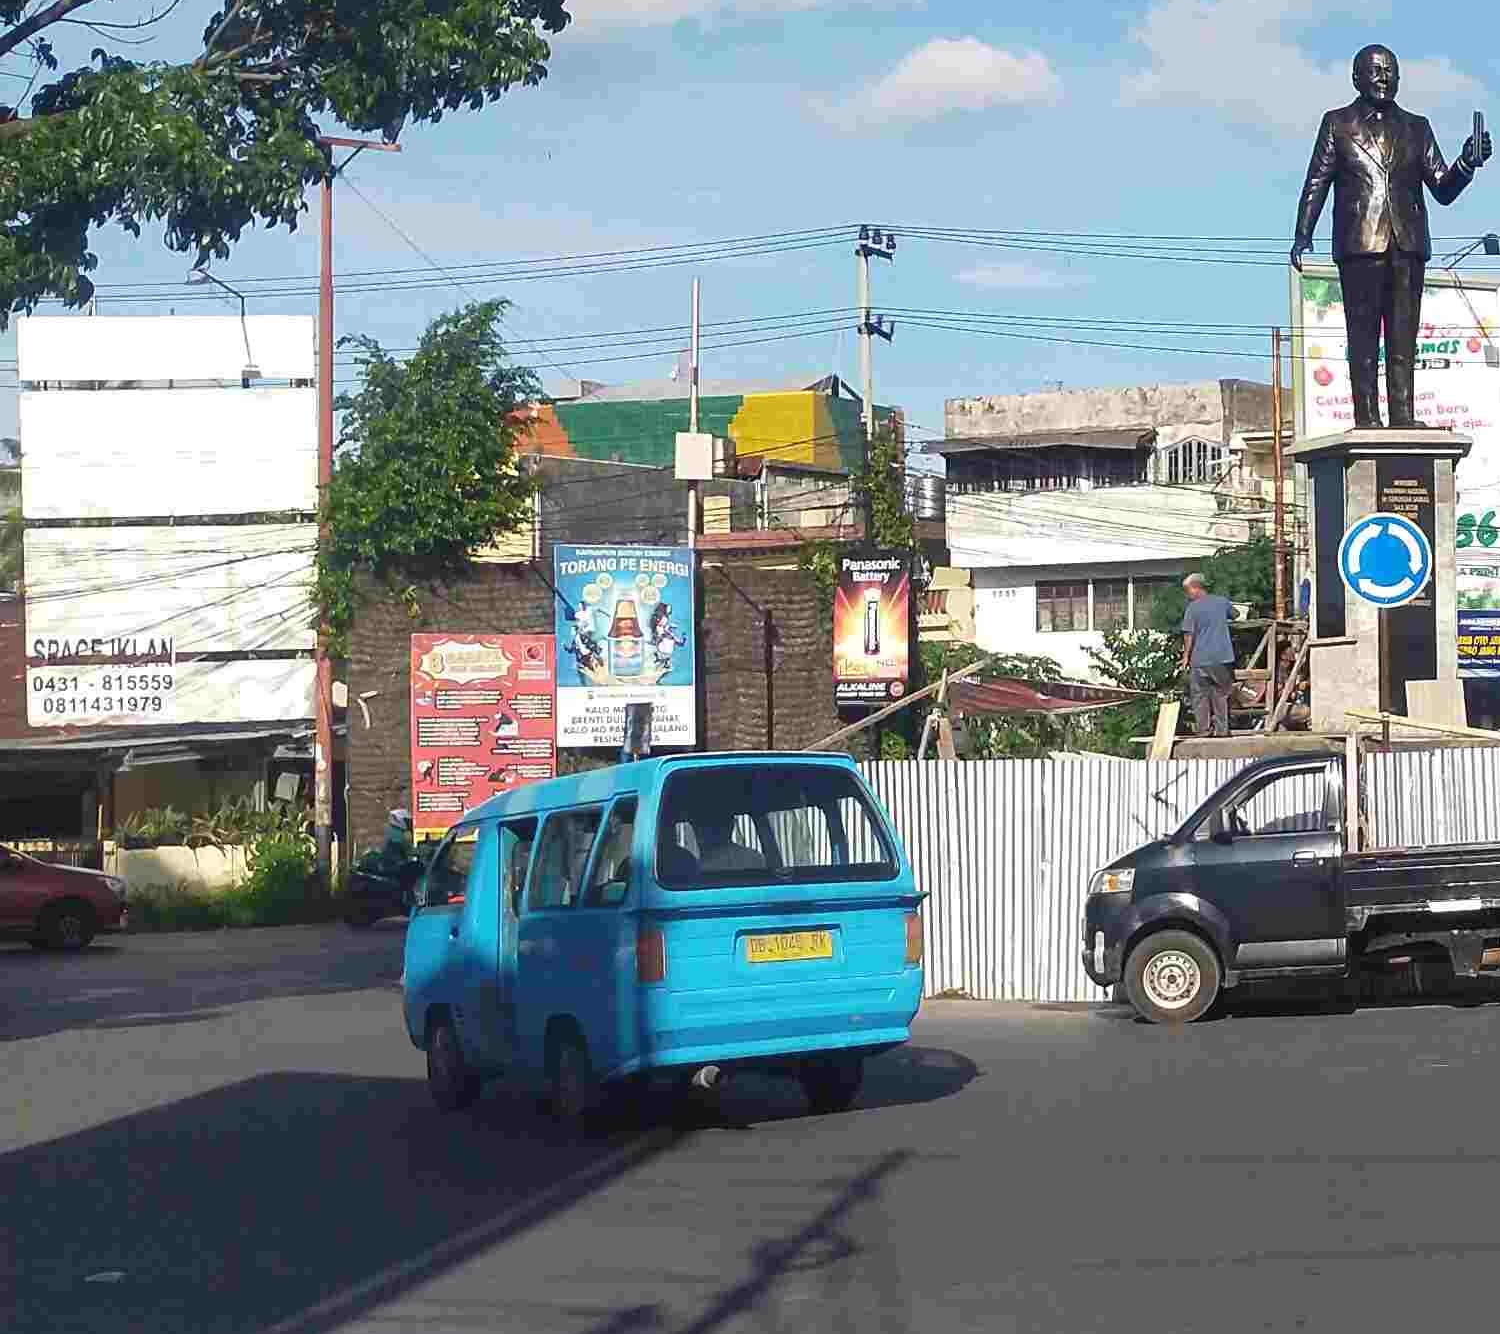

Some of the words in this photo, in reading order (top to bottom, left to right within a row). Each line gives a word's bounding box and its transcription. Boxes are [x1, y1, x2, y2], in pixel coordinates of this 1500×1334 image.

[559, 557, 617, 575] TORANG
[620, 557, 637, 571] PE
[639, 559, 689, 577] ENERGI
[842, 556, 901, 571] Panasonic
[852, 571, 890, 584] Battery
[33, 675, 79, 692] 0431
[102, 674, 174, 691] 815559
[43, 696, 162, 714] 0811431979
